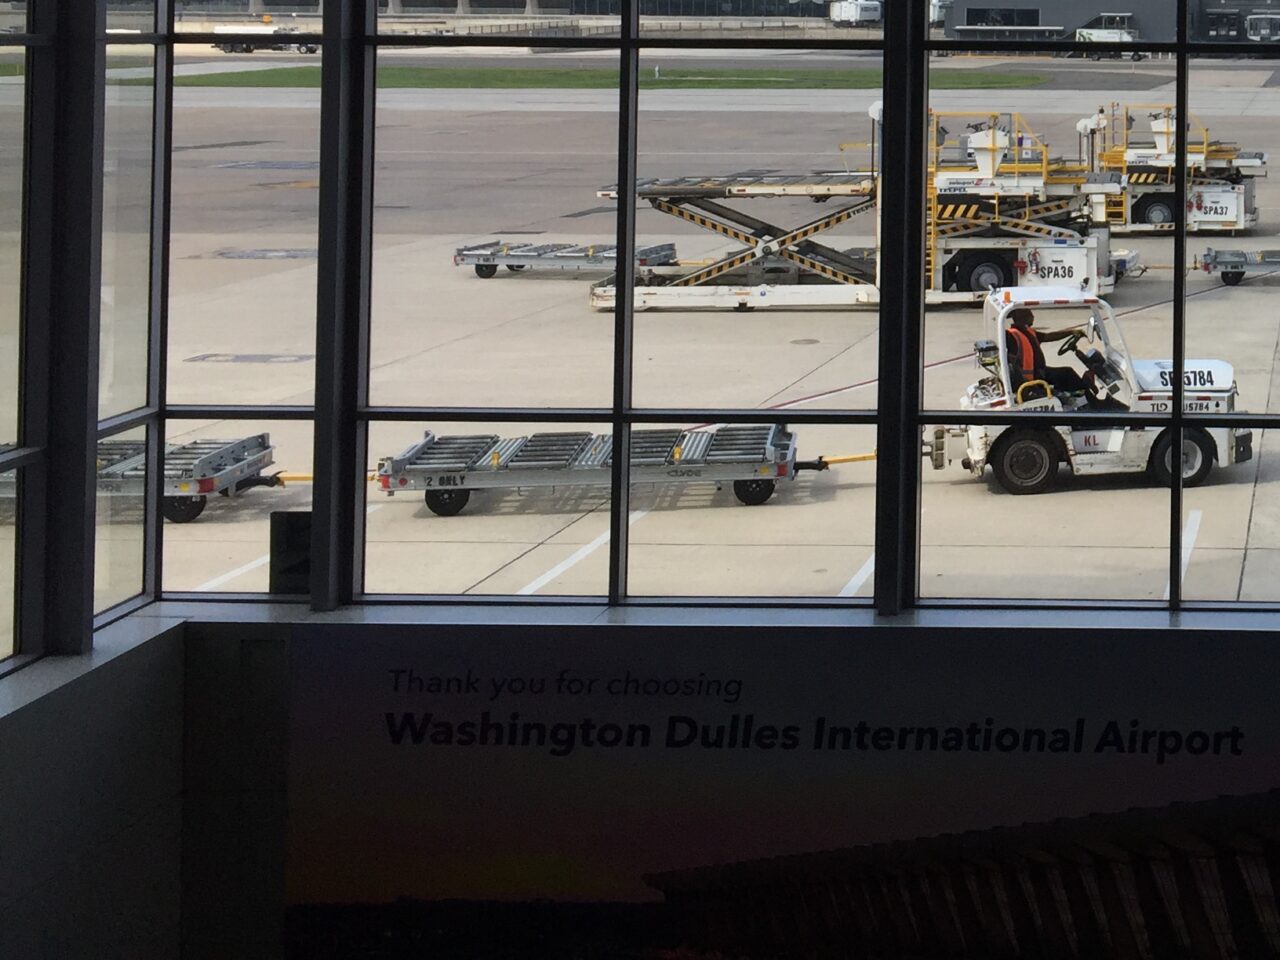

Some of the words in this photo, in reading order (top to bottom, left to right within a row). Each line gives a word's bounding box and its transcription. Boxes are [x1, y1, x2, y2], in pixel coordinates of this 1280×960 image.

[1203, 205, 1229, 217] SPA37
[1040, 266, 1074, 279] SPA36
[1084, 436, 1100, 447] KL
[389, 669, 481, 695] Thank
[488, 675, 548, 701] you
[555, 669, 600, 695] for
[605, 671, 745, 704] choosing
[383, 711, 653, 757] Washington
[665, 714, 801, 751] Dulles
[813, 717, 1087, 754] International
[1094, 720, 1246, 765] Airport
